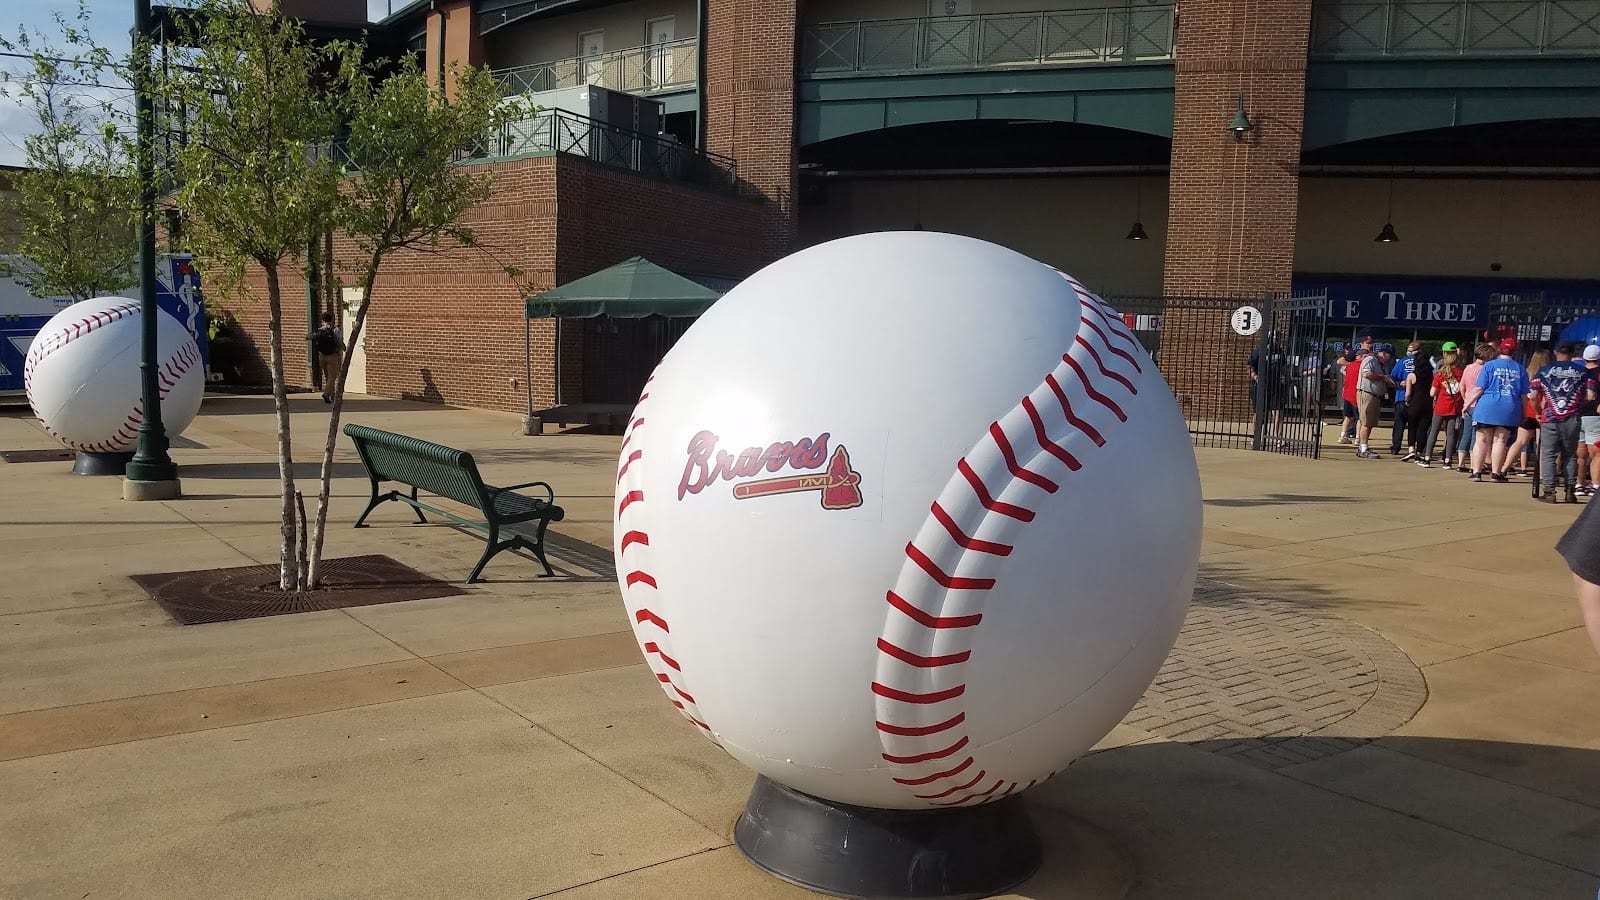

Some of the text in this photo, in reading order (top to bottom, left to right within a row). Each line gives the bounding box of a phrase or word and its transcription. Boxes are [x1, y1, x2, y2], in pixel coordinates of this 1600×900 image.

[1241, 310, 1251, 331] 3
[1380, 291, 1476, 322] THREE
[678, 430, 831, 501] Braves
